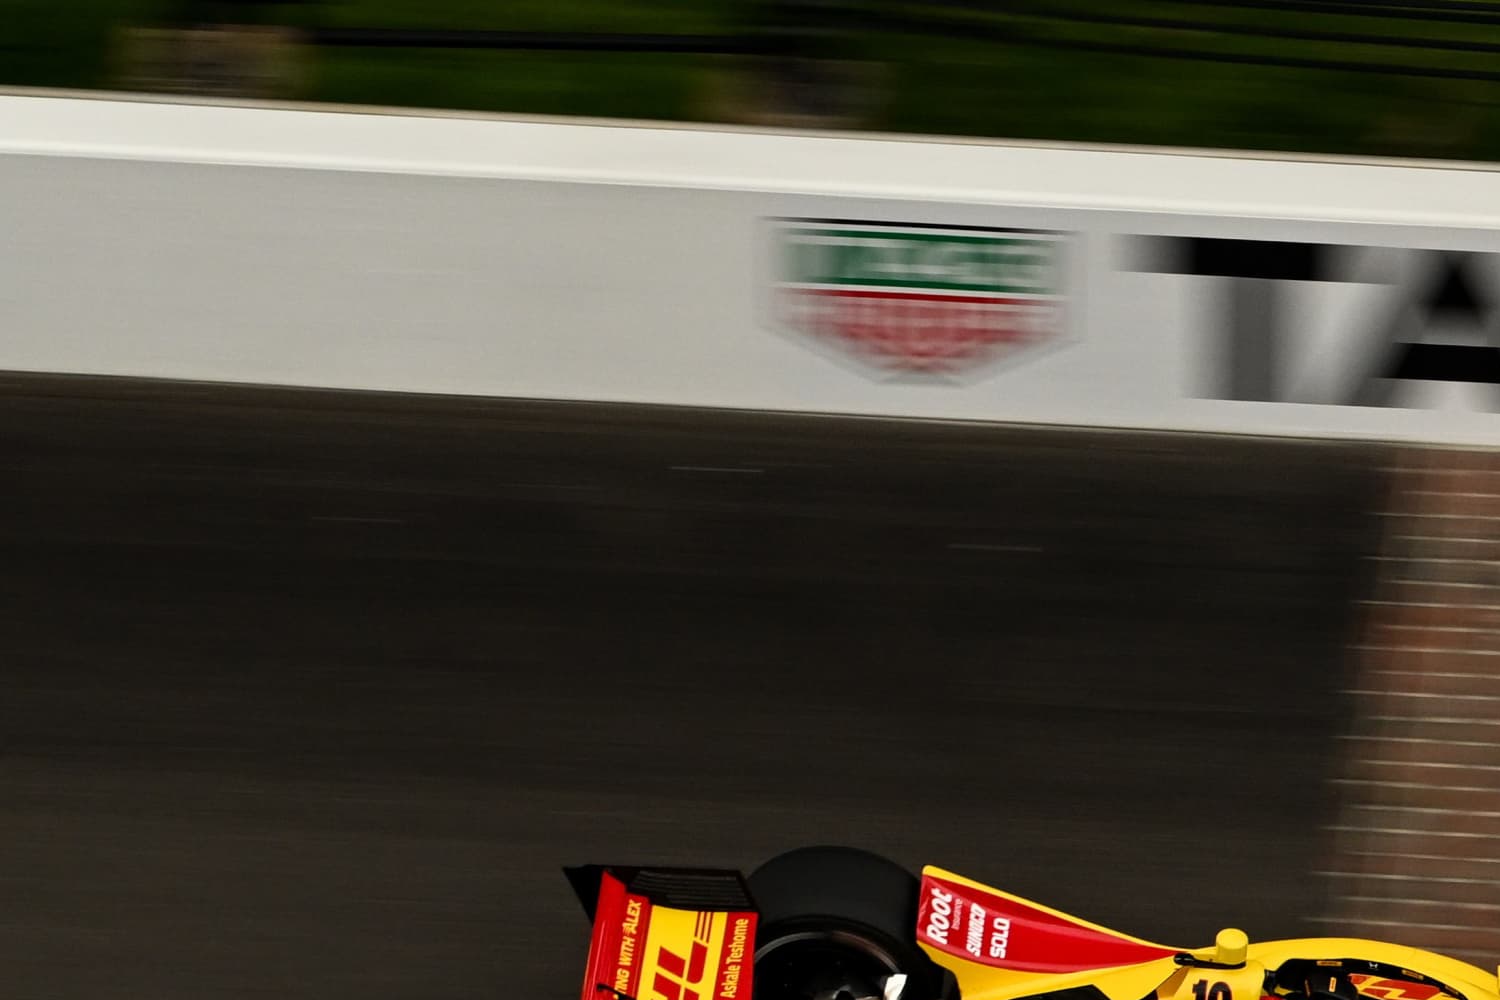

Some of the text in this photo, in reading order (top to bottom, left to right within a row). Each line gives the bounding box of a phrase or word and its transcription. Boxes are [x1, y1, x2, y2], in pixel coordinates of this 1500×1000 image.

[622, 899, 642, 934] ALEX
[966, 902, 986, 957] SUNOCO
[619, 936, 635, 966] WITH
[720, 918, 749, 998] Askale Teshome
[990, 917, 1010, 959] SOLO
